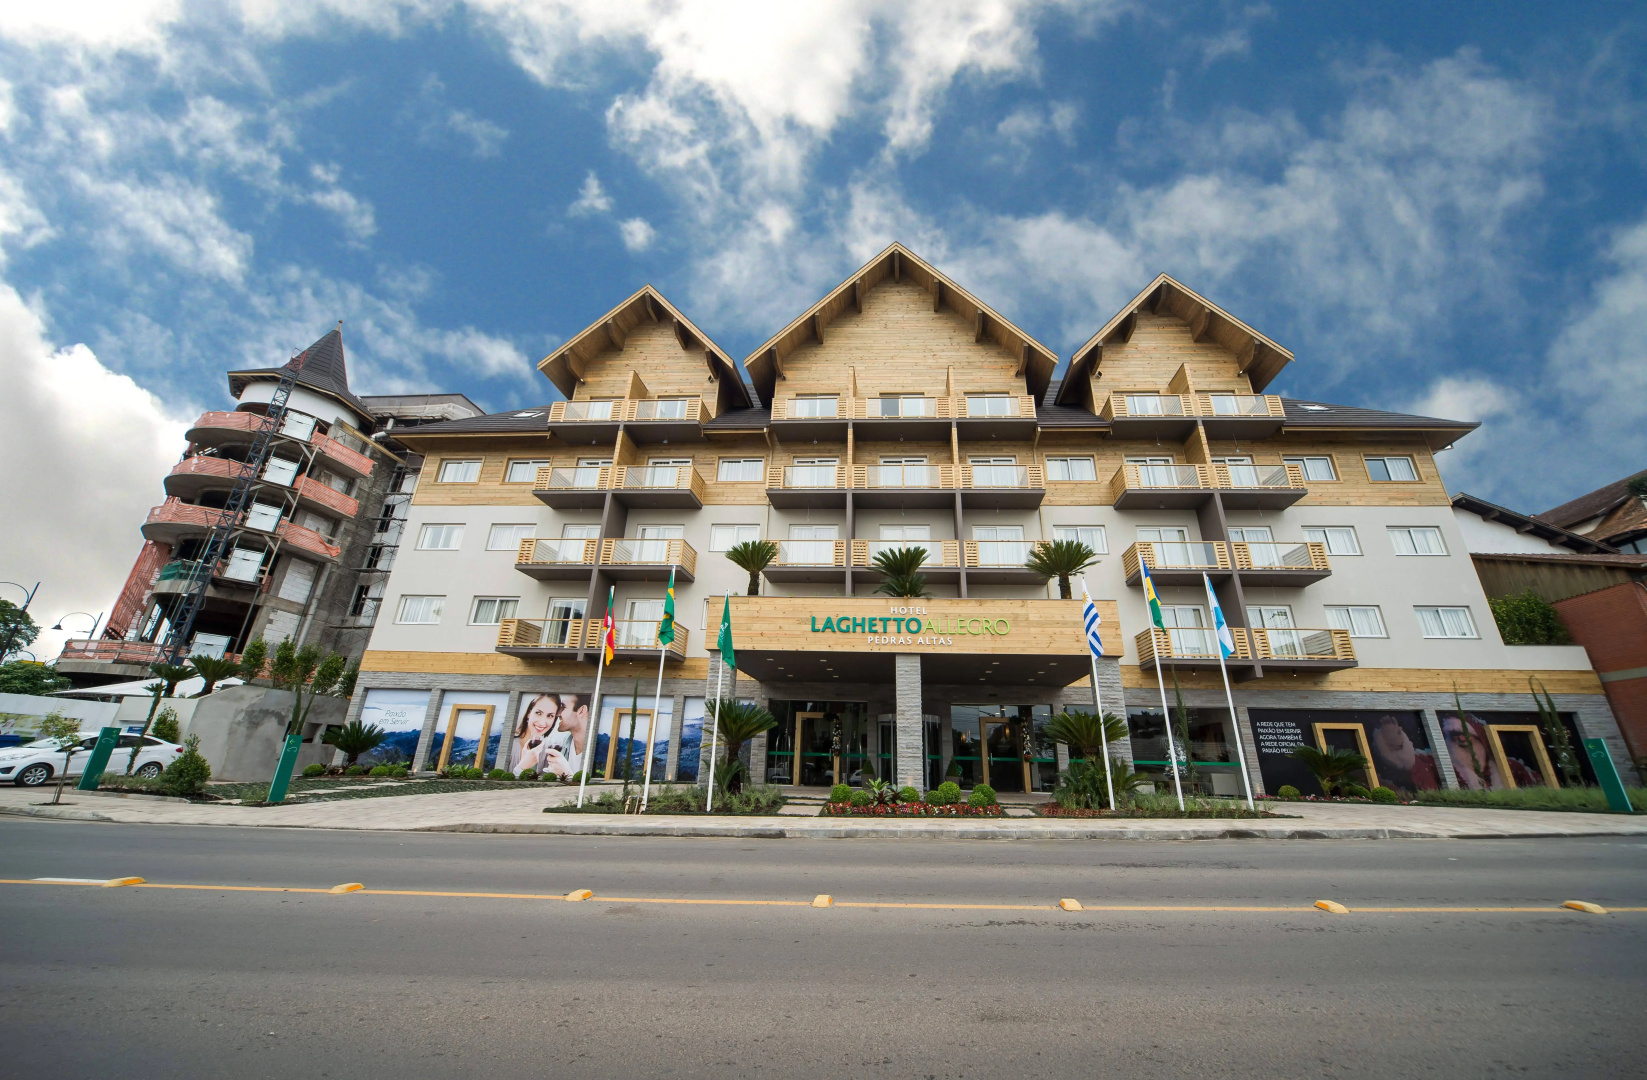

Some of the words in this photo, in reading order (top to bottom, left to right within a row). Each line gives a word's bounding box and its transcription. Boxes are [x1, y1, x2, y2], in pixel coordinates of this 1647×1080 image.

[890, 607, 927, 616] HOTEL
[811, 616, 922, 634] LAGHETTO
[922, 618, 1010, 635] ALLEGRO
[867, 636, 912, 645] PEDRAS
[917, 636, 953, 646] ALTAS
